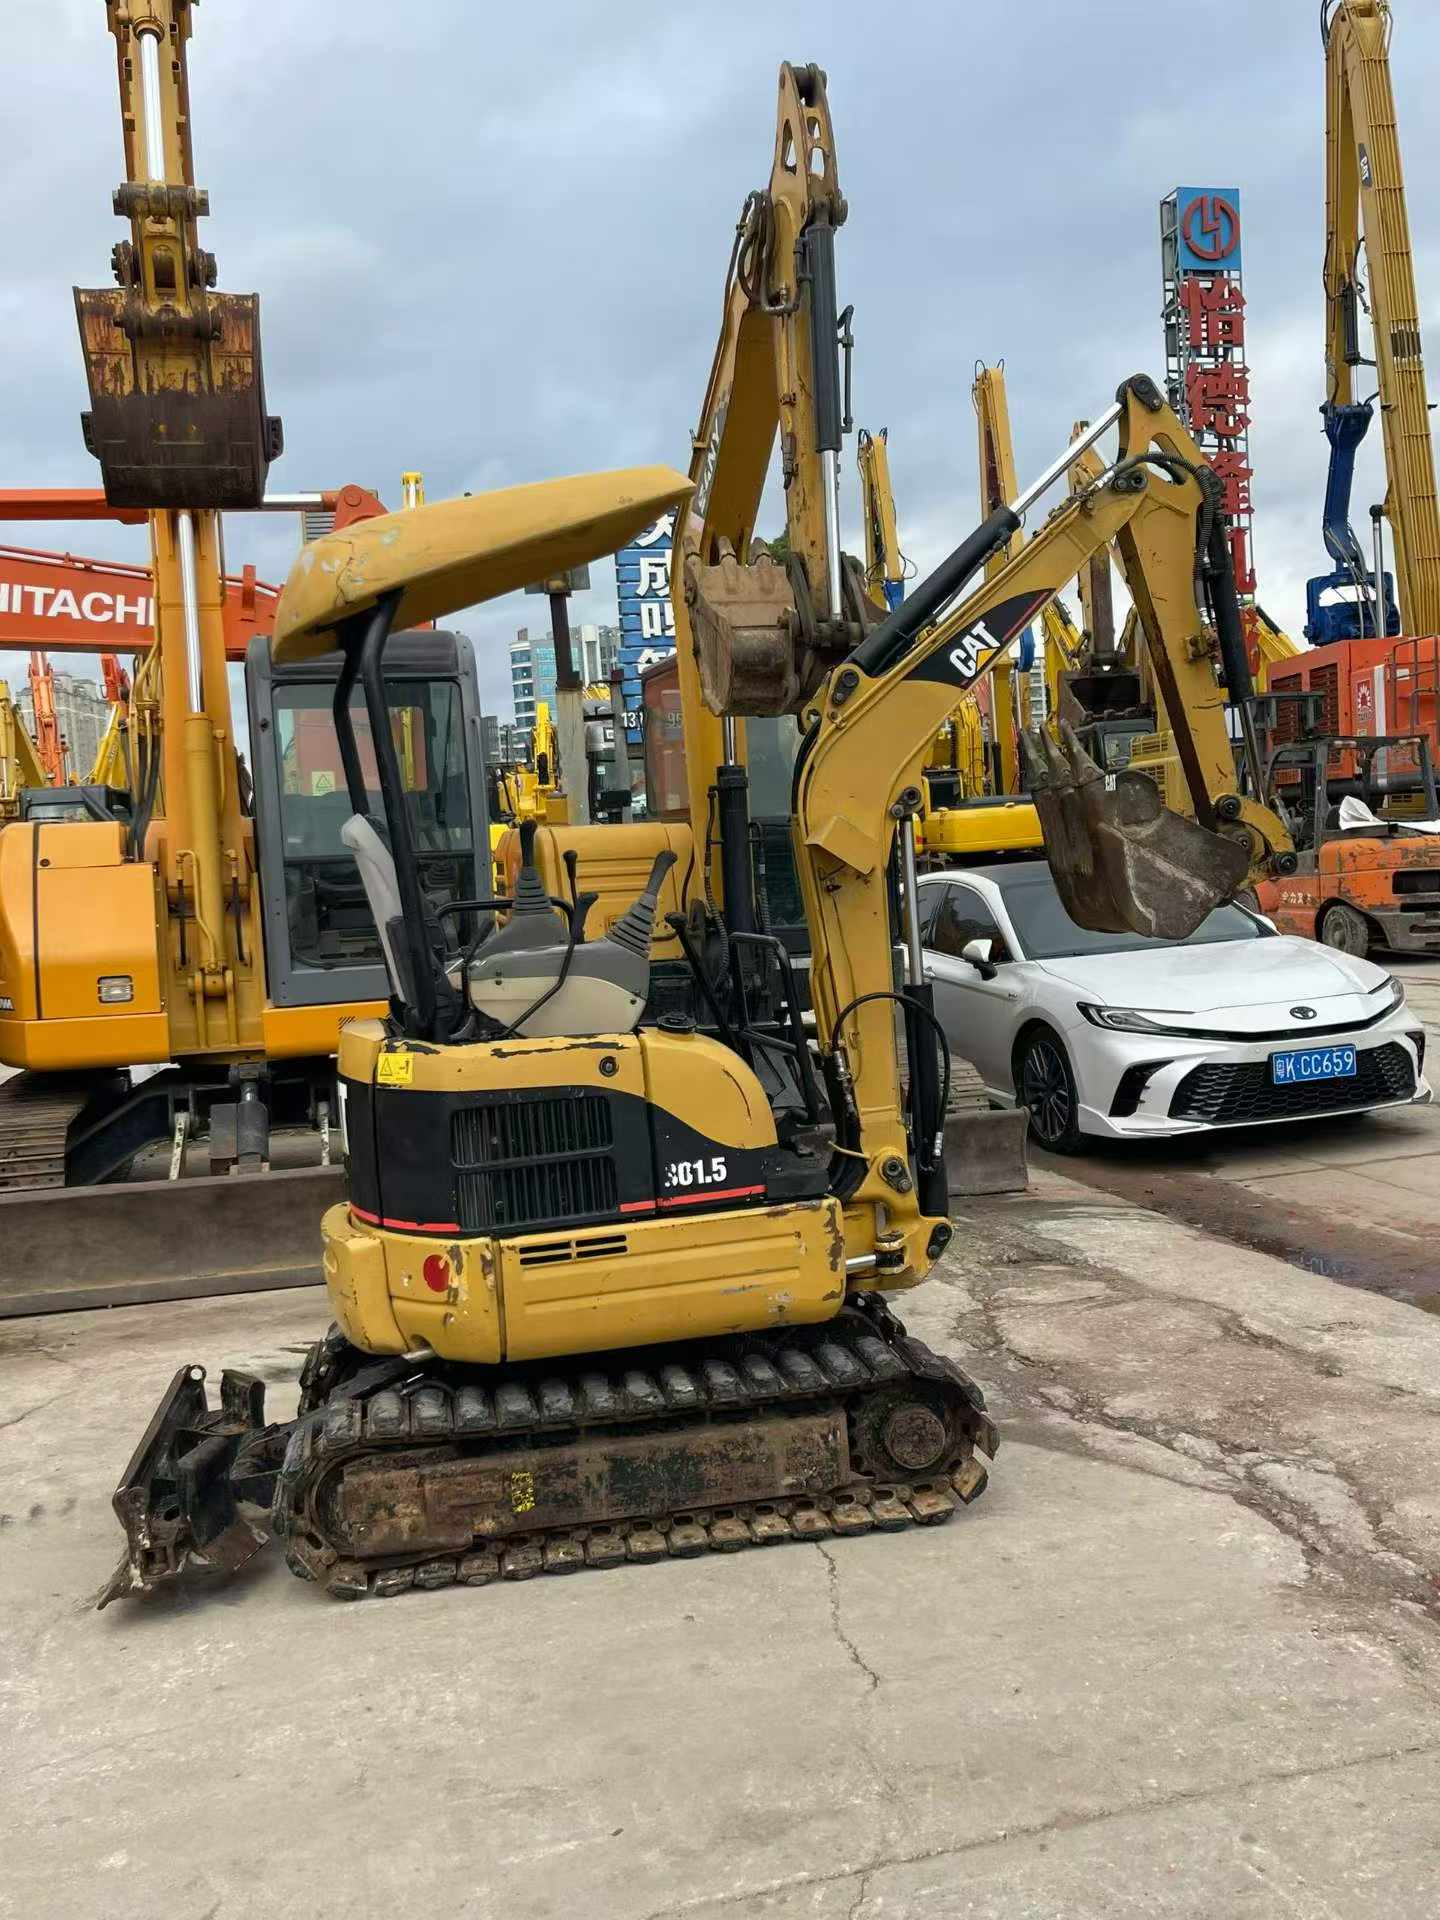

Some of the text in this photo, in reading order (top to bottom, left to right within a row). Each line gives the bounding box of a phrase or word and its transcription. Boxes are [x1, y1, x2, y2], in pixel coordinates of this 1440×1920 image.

[1360, 156, 1369, 181] CAT
[949, 620, 1001, 678] CAT
[621, 711, 643, 729] 13
